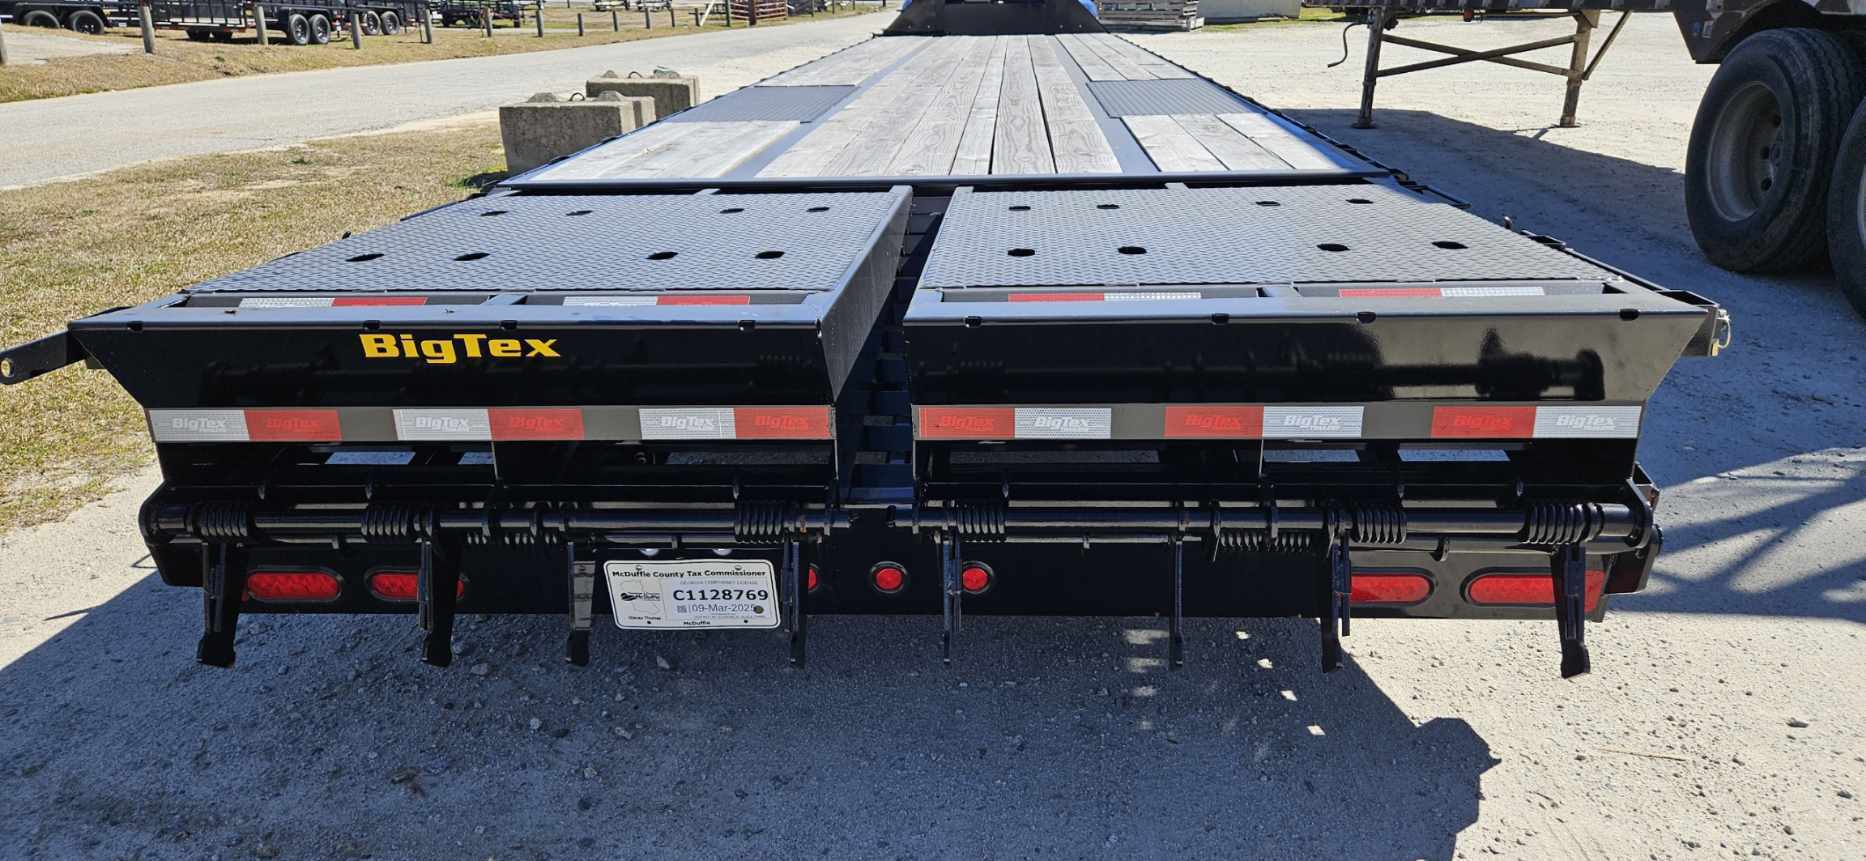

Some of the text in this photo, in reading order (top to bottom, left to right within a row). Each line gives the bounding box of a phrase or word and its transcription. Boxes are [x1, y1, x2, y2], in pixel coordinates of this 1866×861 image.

[359, 333, 561, 364] BigTex
[171, 416, 228, 430] BigTex
[415, 415, 470, 429] BigTex
[660, 415, 715, 429] BigTex
[1033, 415, 1089, 429] BigTex
[1283, 415, 1342, 428] BigTex
[1556, 415, 1617, 428] BigTex
[612, 570, 651, 578] McDuffie
[652, 570, 685, 578] County
[673, 589, 769, 601] C1128769
